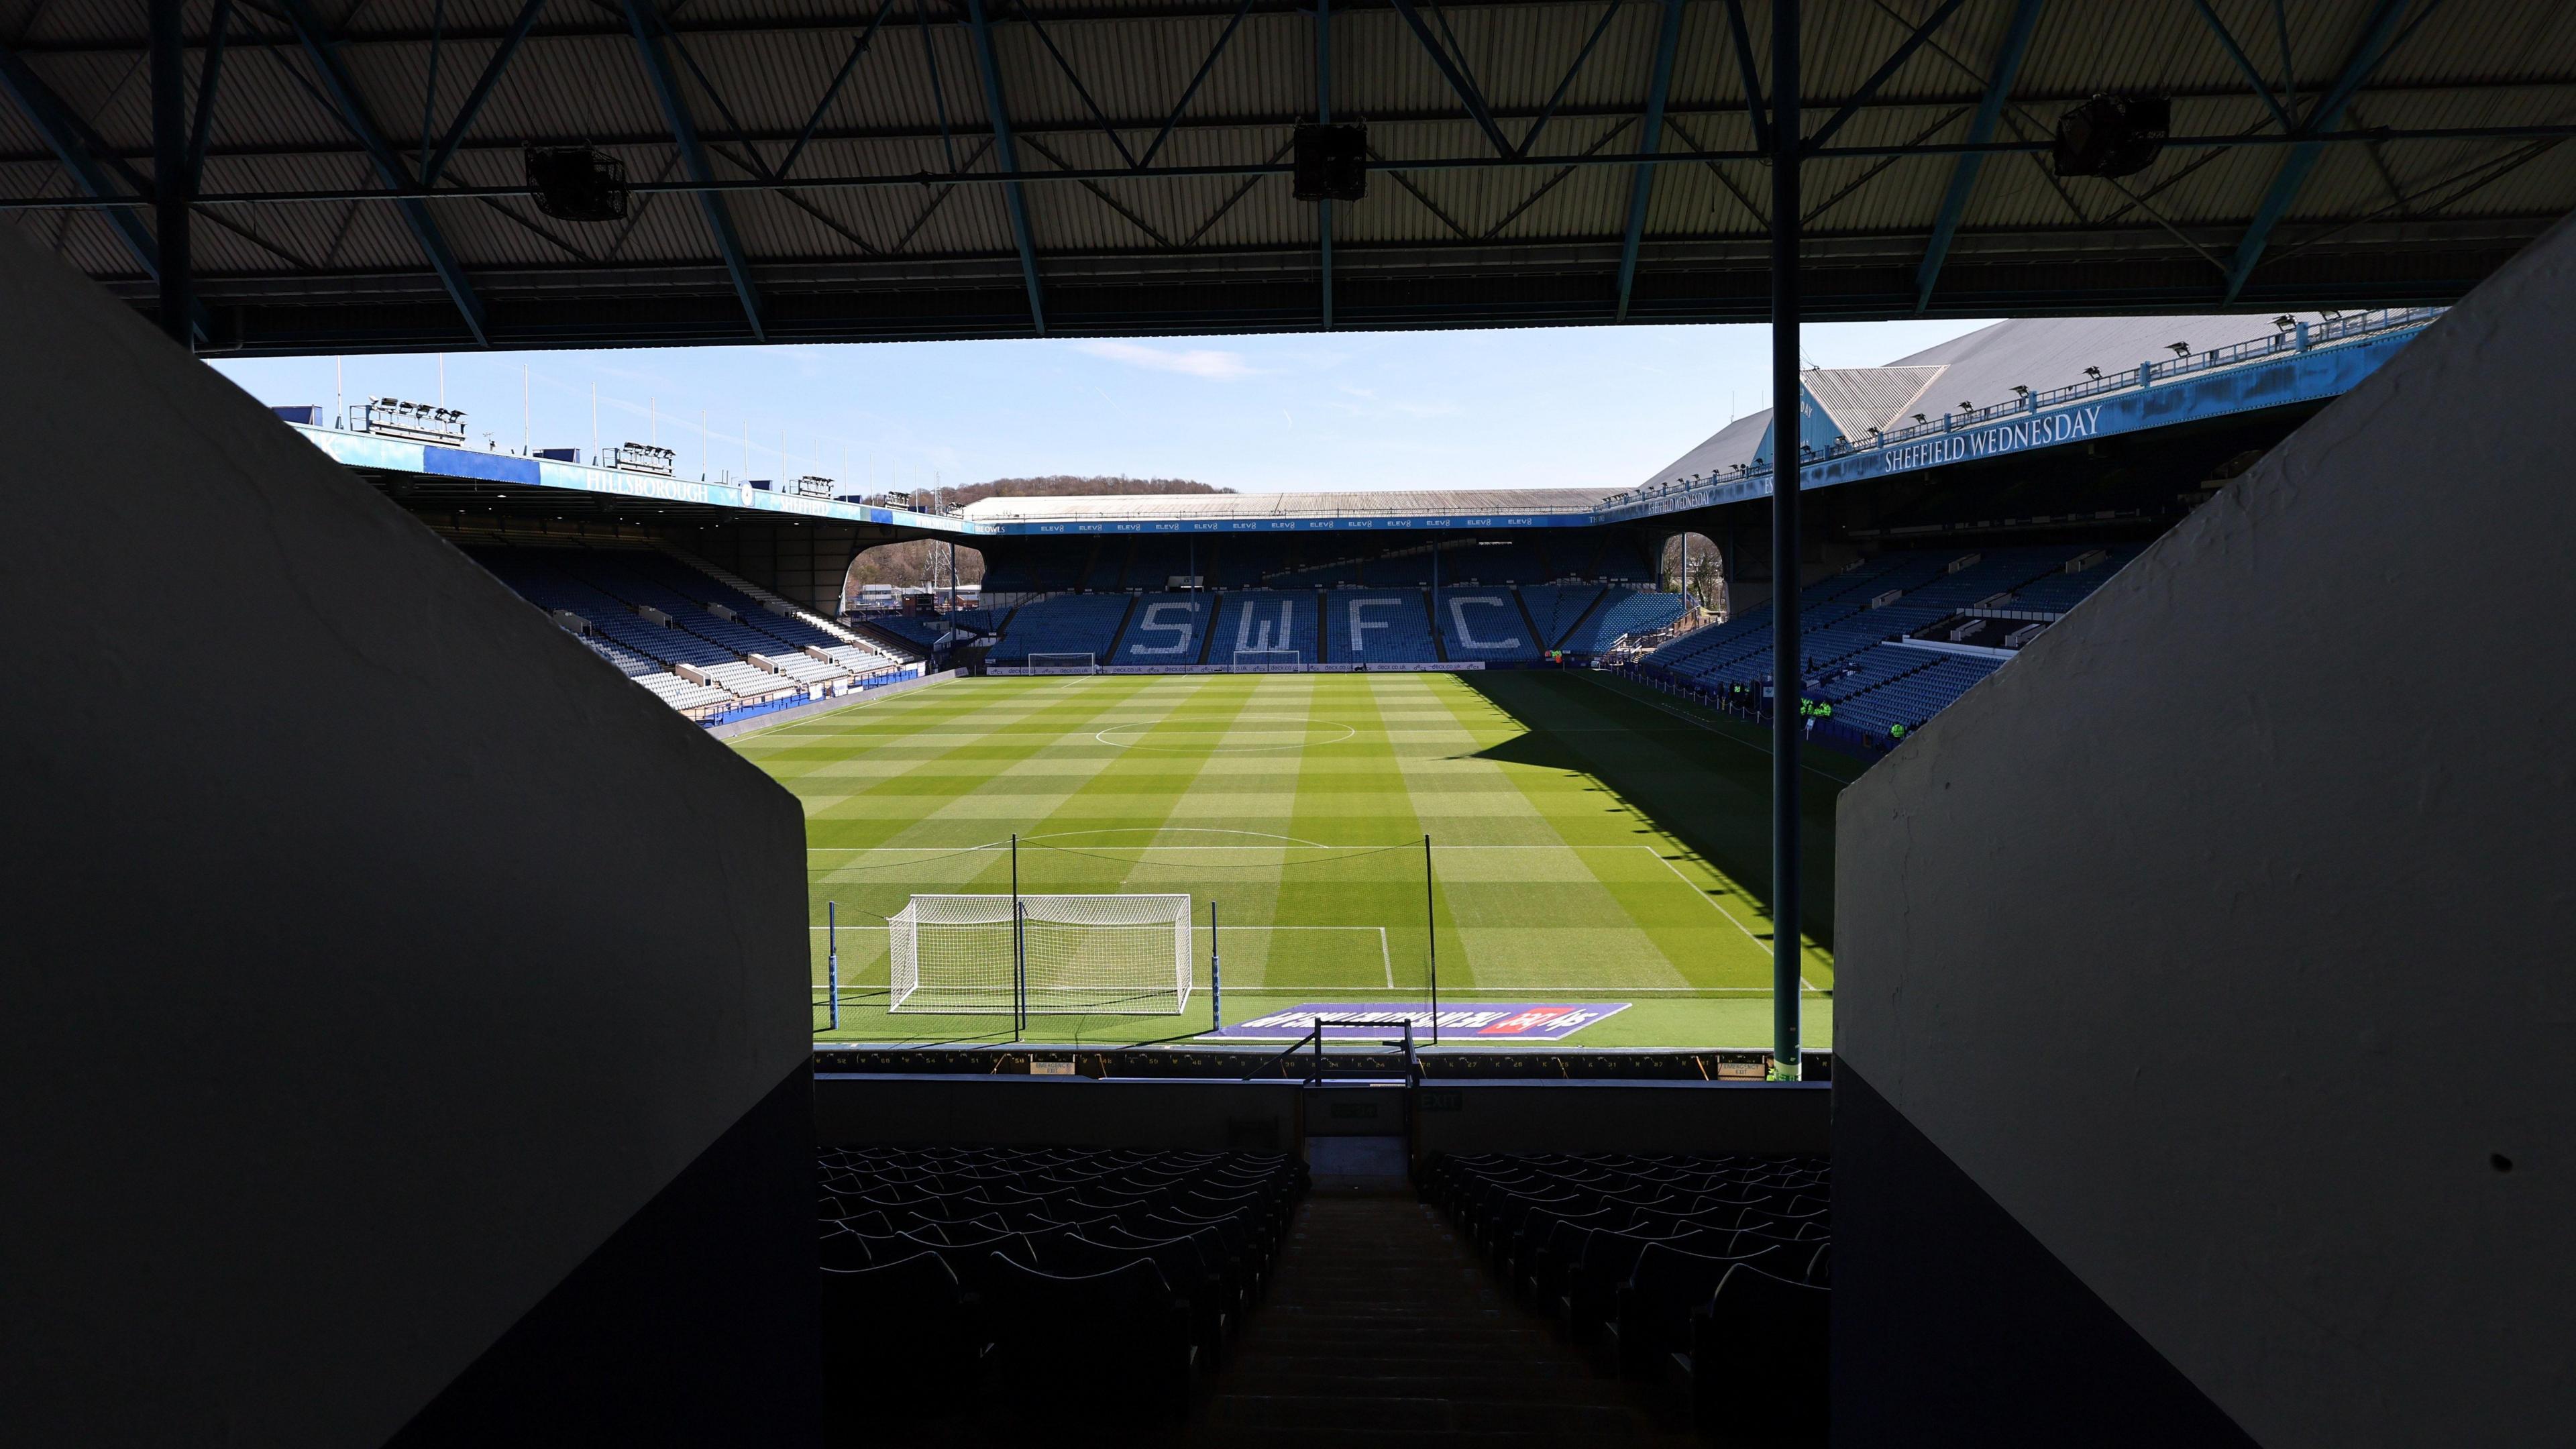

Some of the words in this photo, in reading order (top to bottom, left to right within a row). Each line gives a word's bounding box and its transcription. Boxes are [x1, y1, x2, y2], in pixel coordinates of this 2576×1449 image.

[1885, 436, 1965, 473] SHEFFIELD
[1970, 405, 2102, 457] WEDNESDAY
[586, 469, 708, 502] HILLSBOROUGH
[1648, 498, 1674, 515] SHEFFIELD
[1675, 490, 1710, 510] WEDNESDAY
[985, 525, 1005, 533] OWLS
[1421, 1093, 1458, 1108] EXIT
